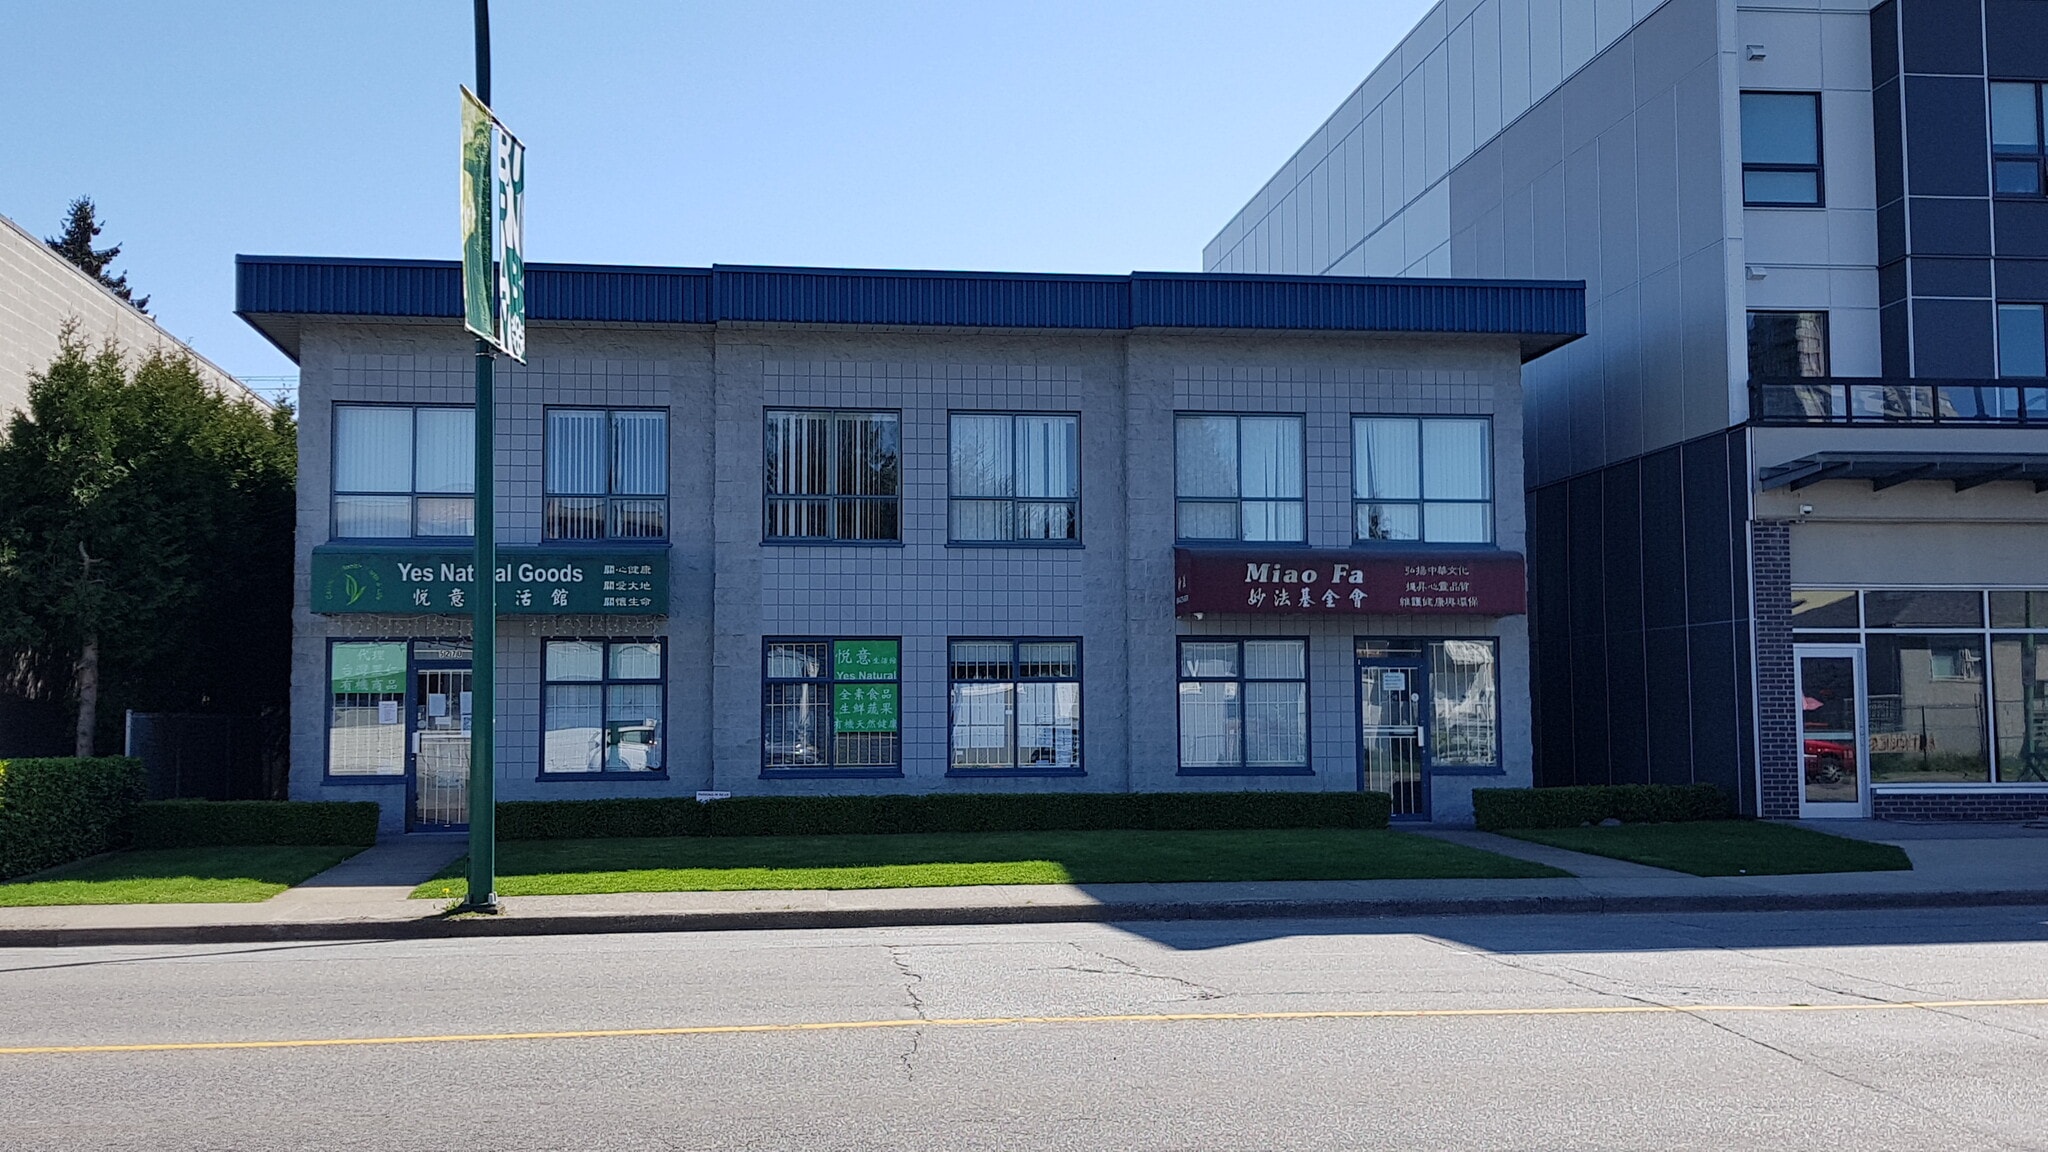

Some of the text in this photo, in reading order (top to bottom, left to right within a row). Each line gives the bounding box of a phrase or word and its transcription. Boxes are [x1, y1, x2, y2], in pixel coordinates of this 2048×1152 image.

[397, 562, 434, 583] Yes
[440, 562, 512, 583] Natal
[518, 562, 584, 583] Goods
[603, 564, 652, 575] 關心健康
[1244, 562, 1364, 584] Miao Fa
[603, 580, 652, 591] 關愛大地
[1247, 586, 1369, 609] 妙法基金會
[836, 671, 897, 680] Yes Natural
[339, 678, 398, 691] 有機商品
[839, 687, 892, 701] 全素食品
[839, 702, 893, 715] 生鮮蔬果
